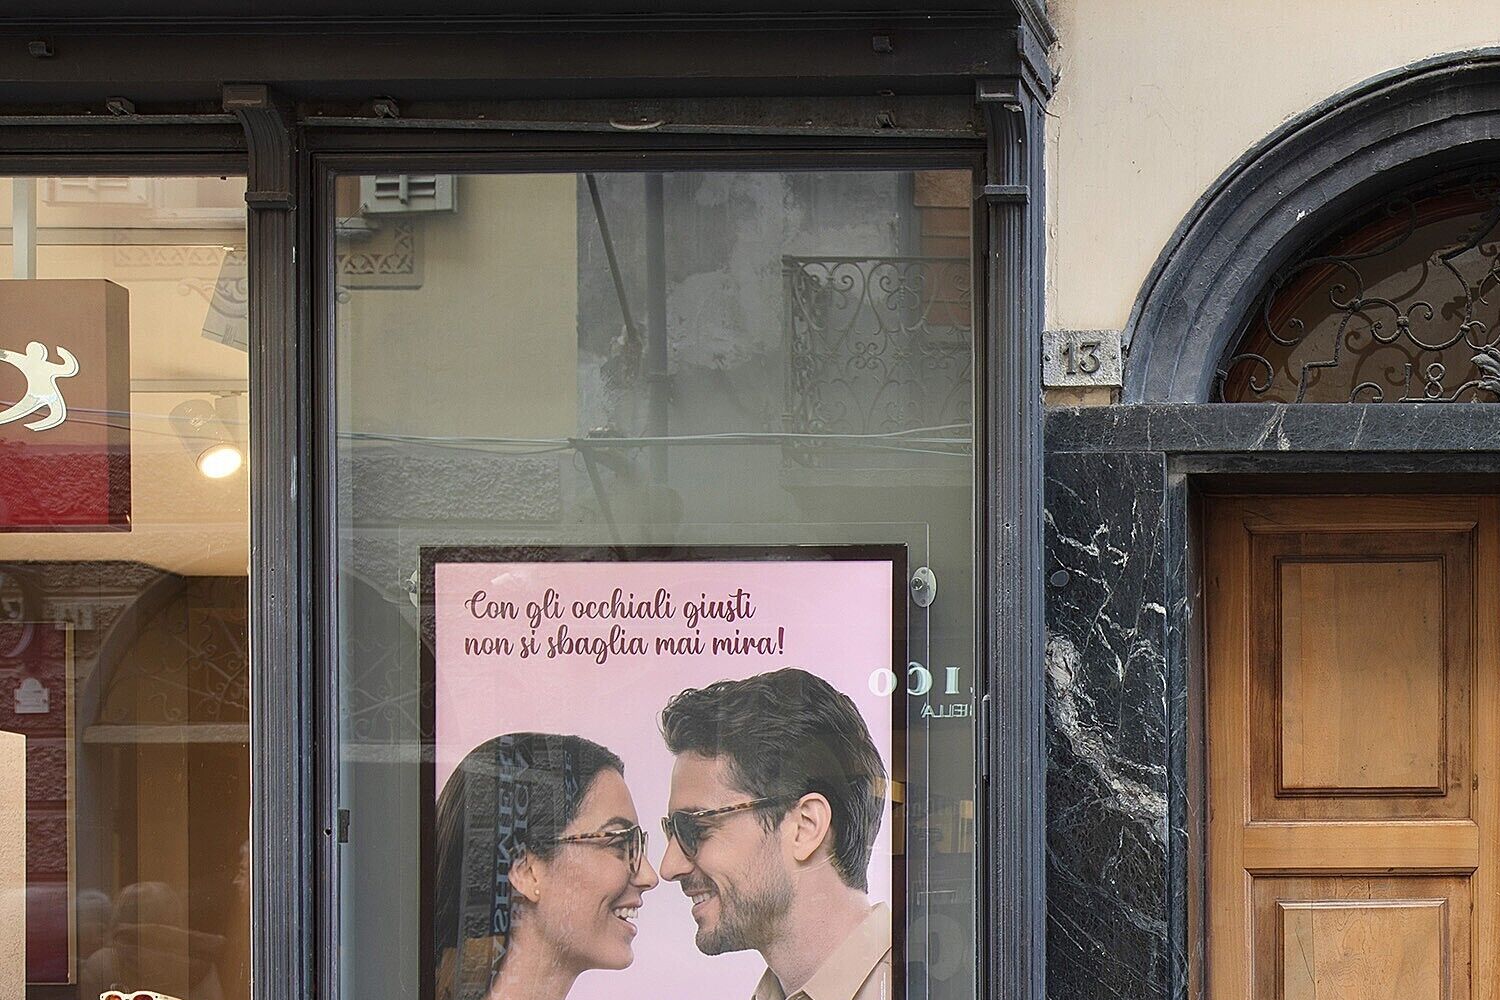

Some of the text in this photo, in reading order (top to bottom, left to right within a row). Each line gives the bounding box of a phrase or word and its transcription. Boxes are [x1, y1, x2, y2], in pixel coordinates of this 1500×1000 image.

[1062, 341, 1100, 375] 13
[464, 587, 757, 629] Con gli occhiali giusti
[464, 624, 785, 664] non si sbaglia mai mira!
